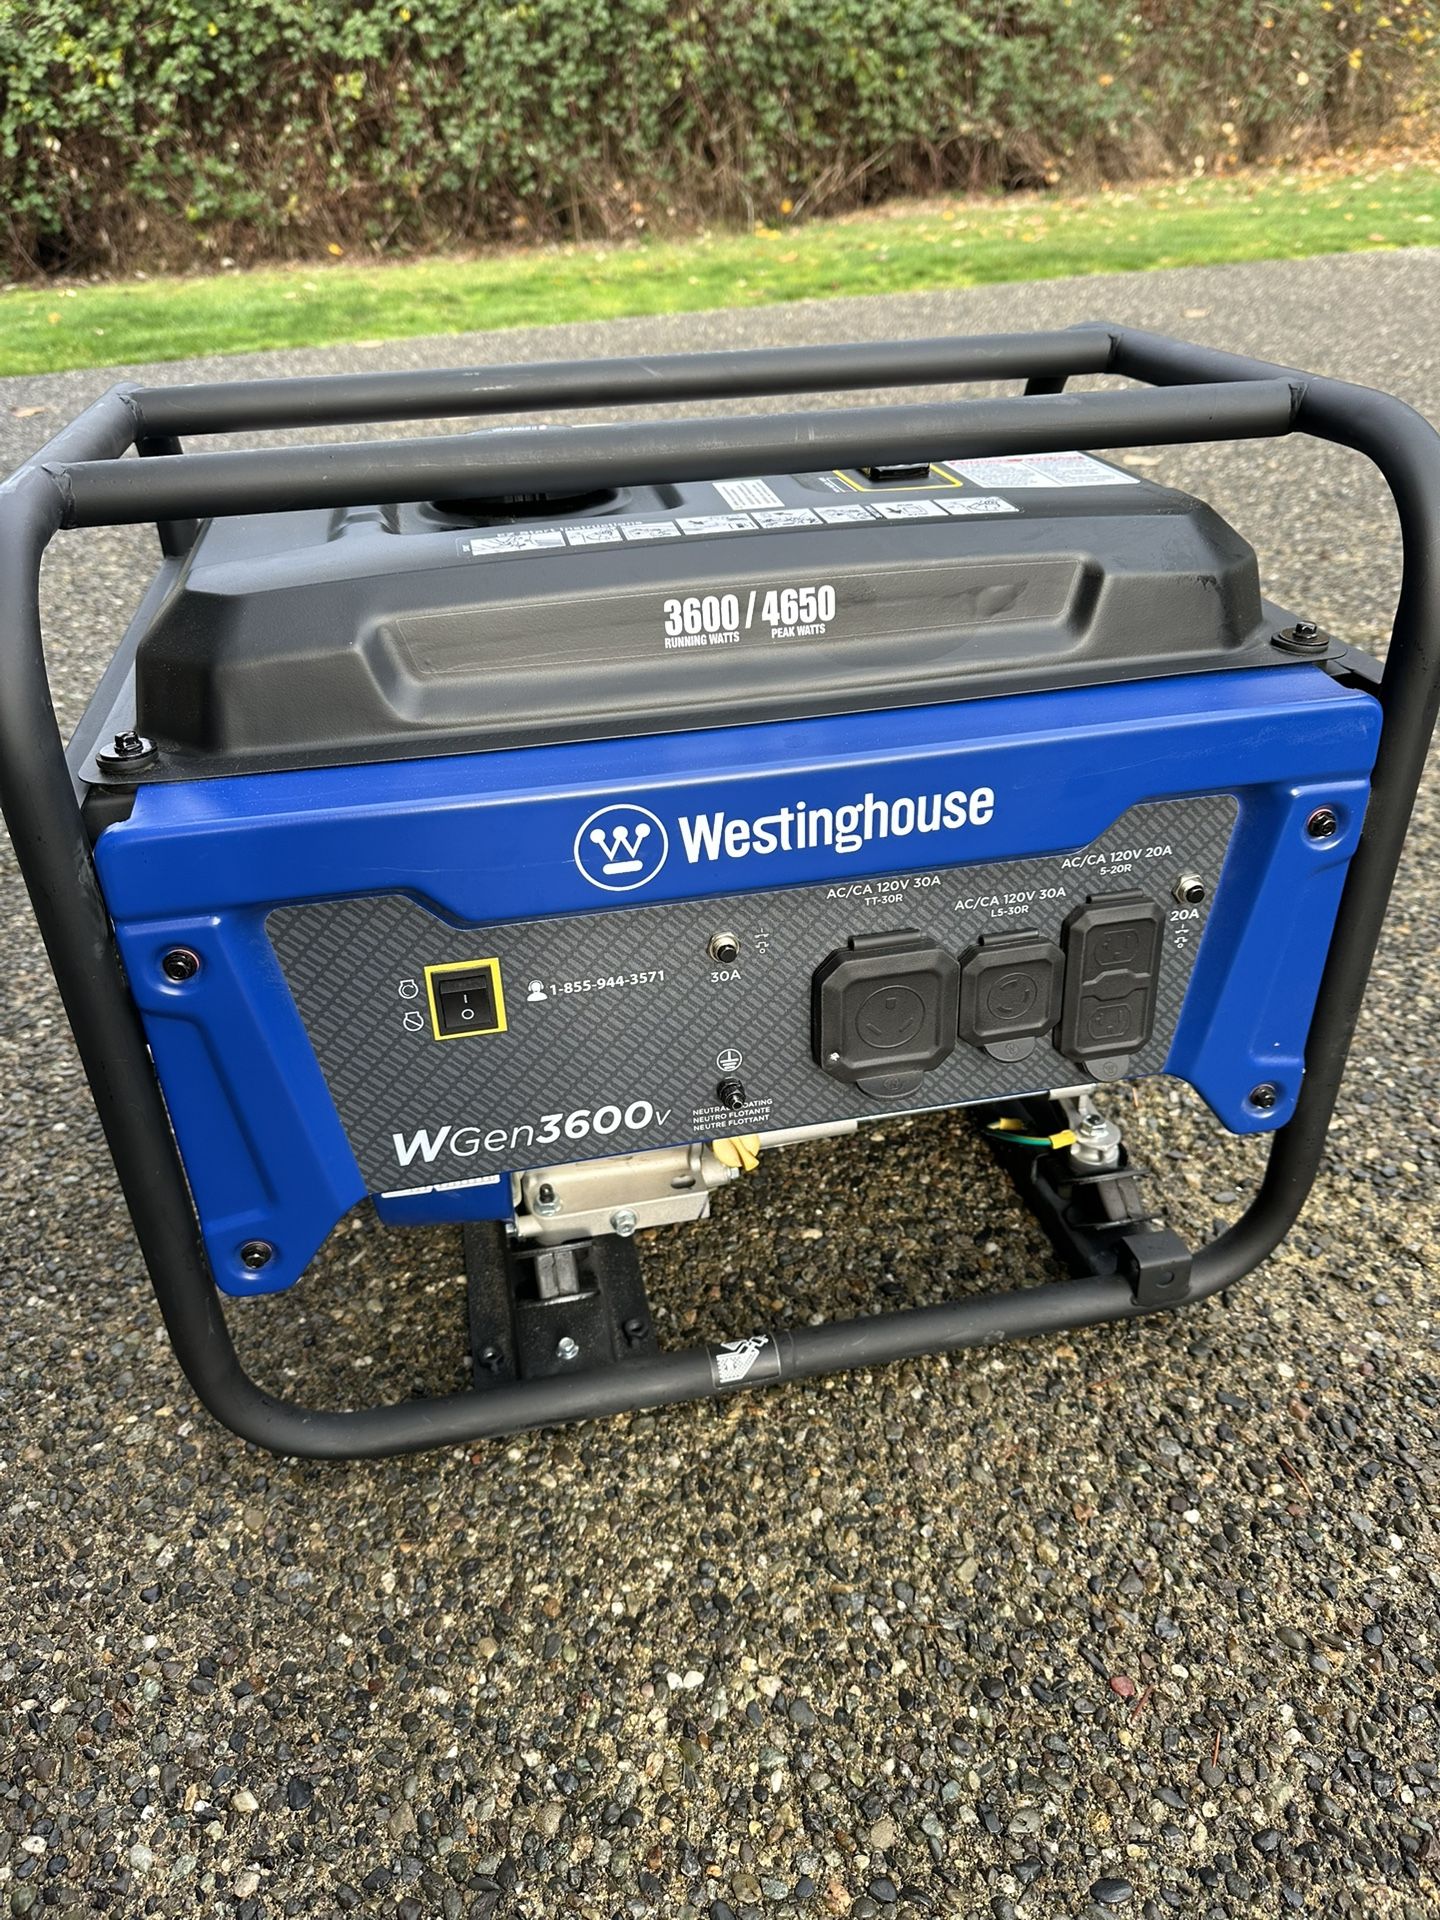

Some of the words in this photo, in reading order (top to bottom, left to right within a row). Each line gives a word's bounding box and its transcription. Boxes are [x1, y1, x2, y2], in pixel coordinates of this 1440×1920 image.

[663, 593, 740, 636] 3600
[744, 590, 757, 630] /
[761, 584, 836, 627] 4650
[664, 634, 708, 649] RUNNING
[708, 631, 740, 645] WATTS
[771, 627, 795, 639] PEAK
[796, 623, 826, 637] WATTS
[678, 786, 996, 864] Westinghouse
[1061, 854, 1107, 869] AC/CA
[1110, 849, 1143, 863] 120V
[1145, 845, 1172, 858] 20A
[1100, 863, 1132, 876] 5-20R
[826, 885, 873, 900] AC/CA
[876, 879, 910, 893] 120V
[913, 875, 942, 888] 30A
[864, 893, 904, 906] TT-30R
[954, 896, 1000, 912] AC/CA
[1002, 891, 1036, 905] 120V
[1038, 887, 1067, 900] 30A
[990, 905, 1030, 918] L5-30R
[1169, 908, 1200, 922] 20A
[549, 970, 666, 996] 1-855-944-3571
[710, 970, 742, 983] 30A
[742, 1098, 773, 1109] OATING
[693, 1113, 727, 1124] NEUTRO
[728, 1106, 771, 1118] FLOTANTE
[693, 1120, 727, 1132] NEUTRE
[728, 1114, 770, 1126] FLOTTANT
